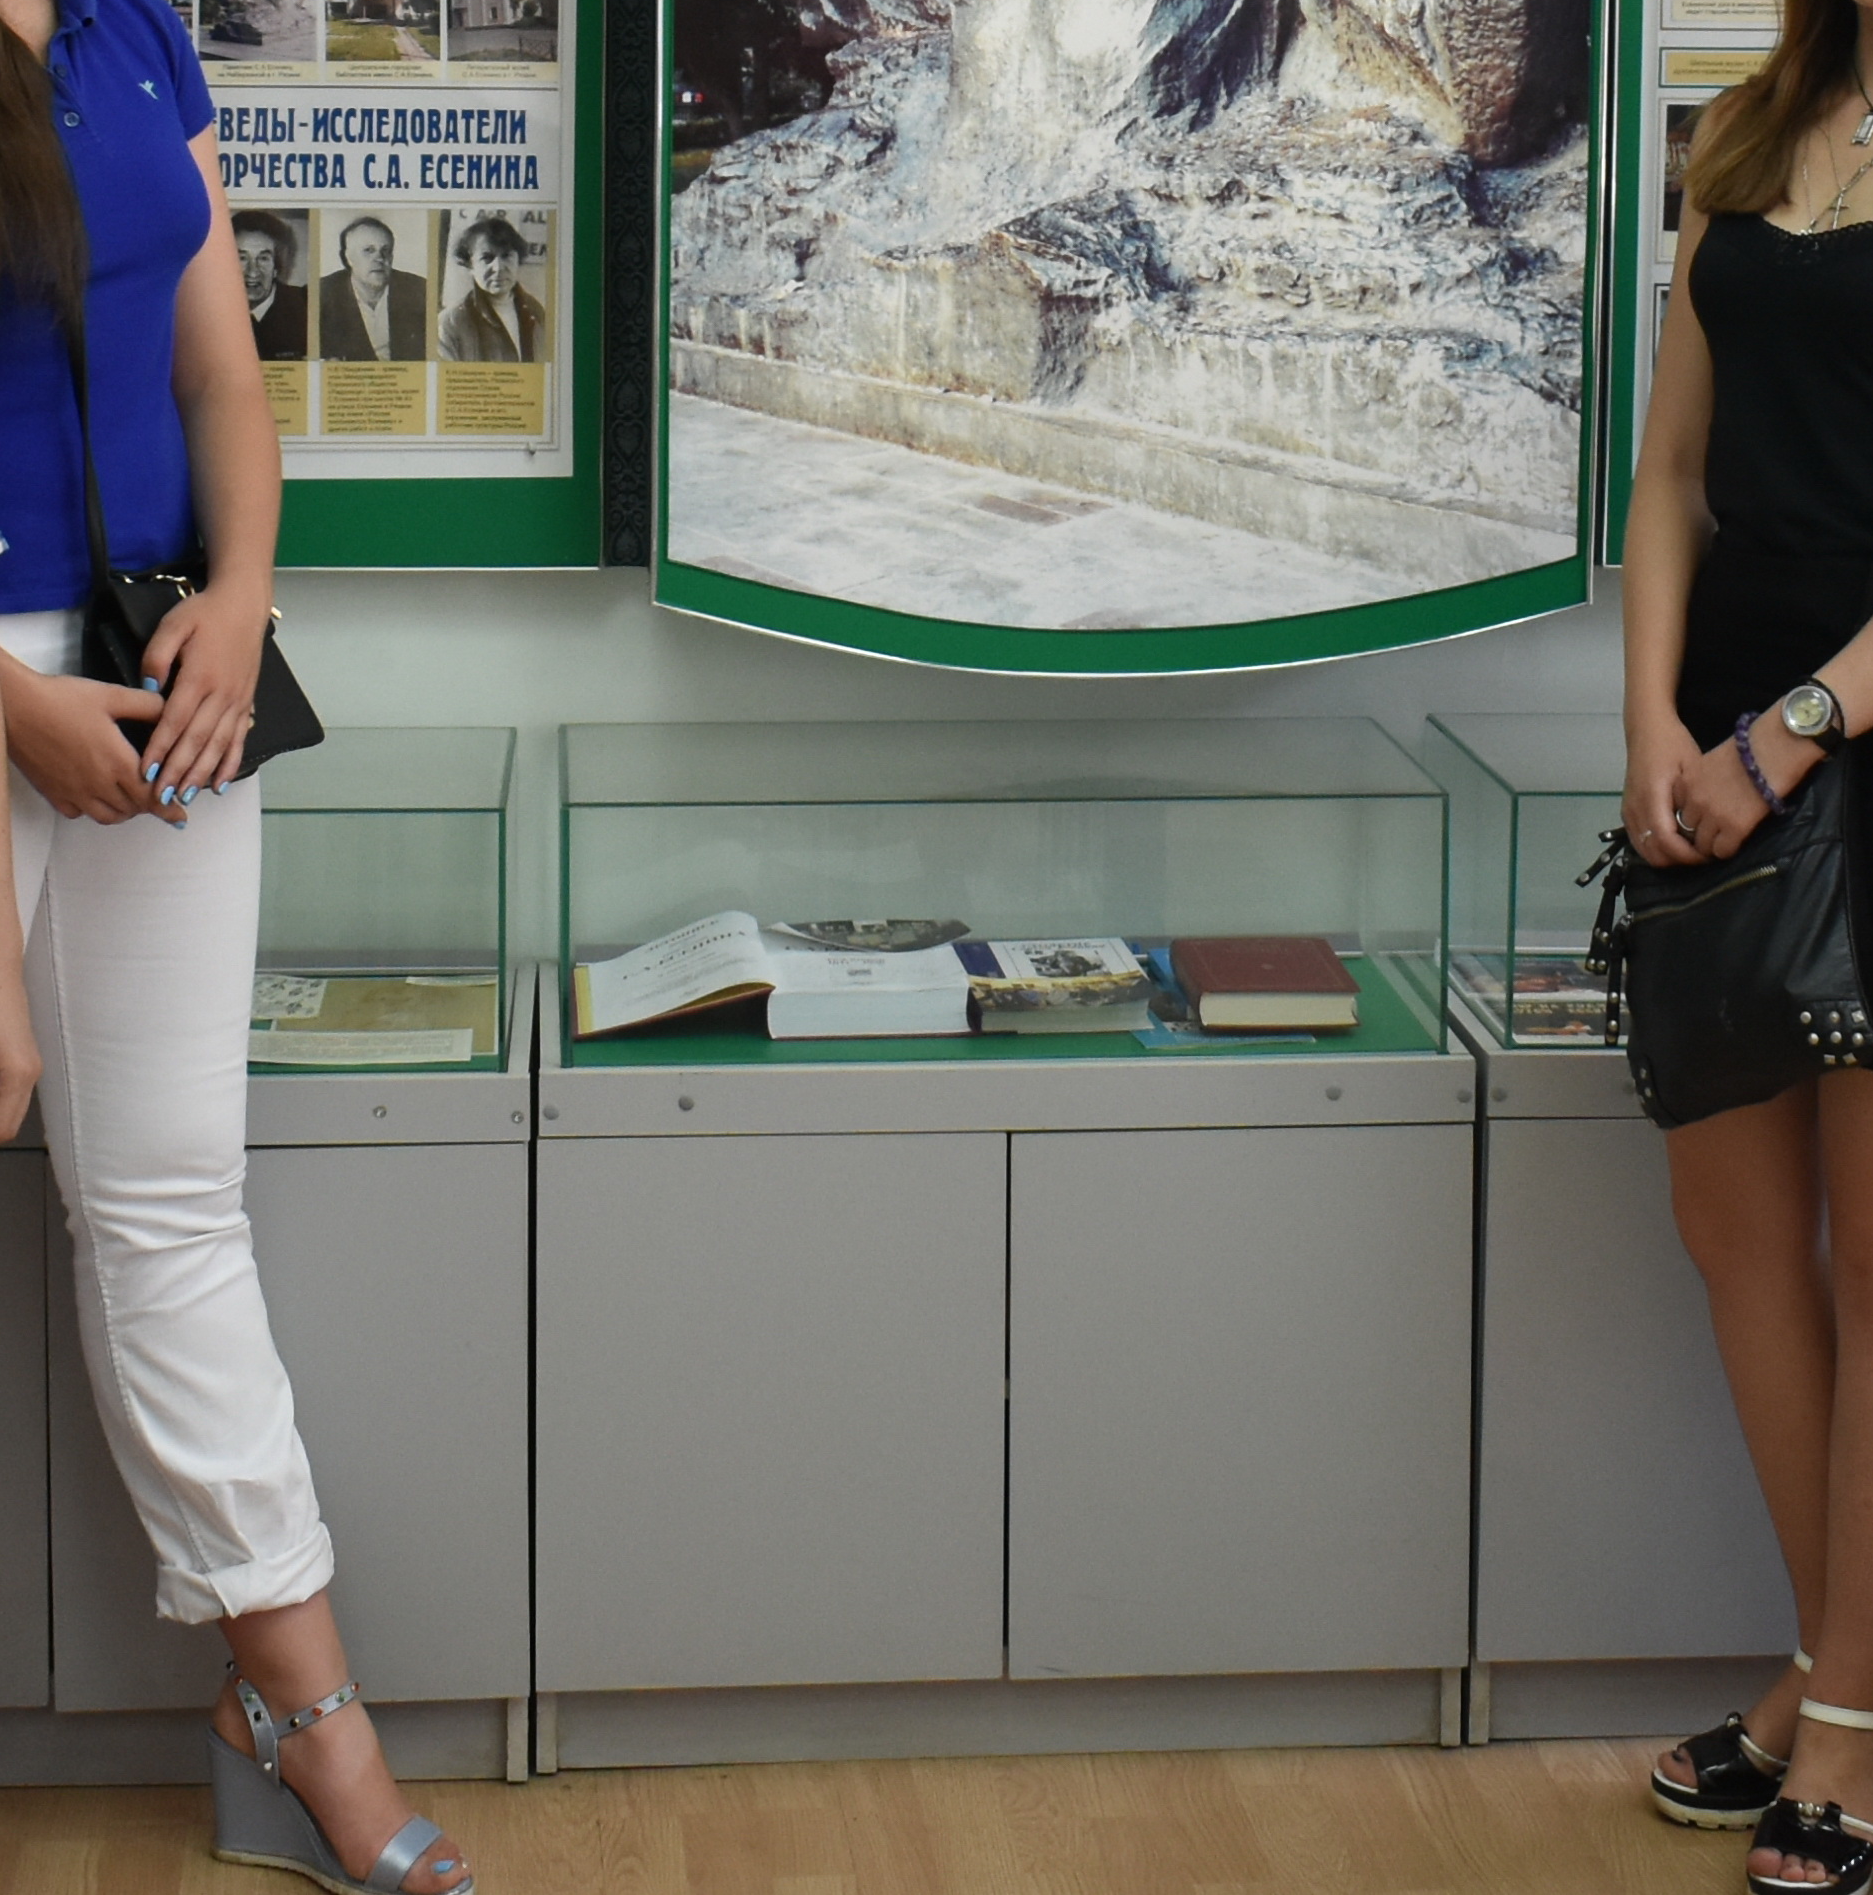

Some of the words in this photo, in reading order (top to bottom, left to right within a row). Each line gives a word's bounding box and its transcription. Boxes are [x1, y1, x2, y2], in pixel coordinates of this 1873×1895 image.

[214, 107, 527, 149] ВЕДЫ-ИССЛЕДОВАТЕЛИ
[363, 153, 410, 190] С.А.
[420, 153, 539, 191] ЕСЕНИНА
